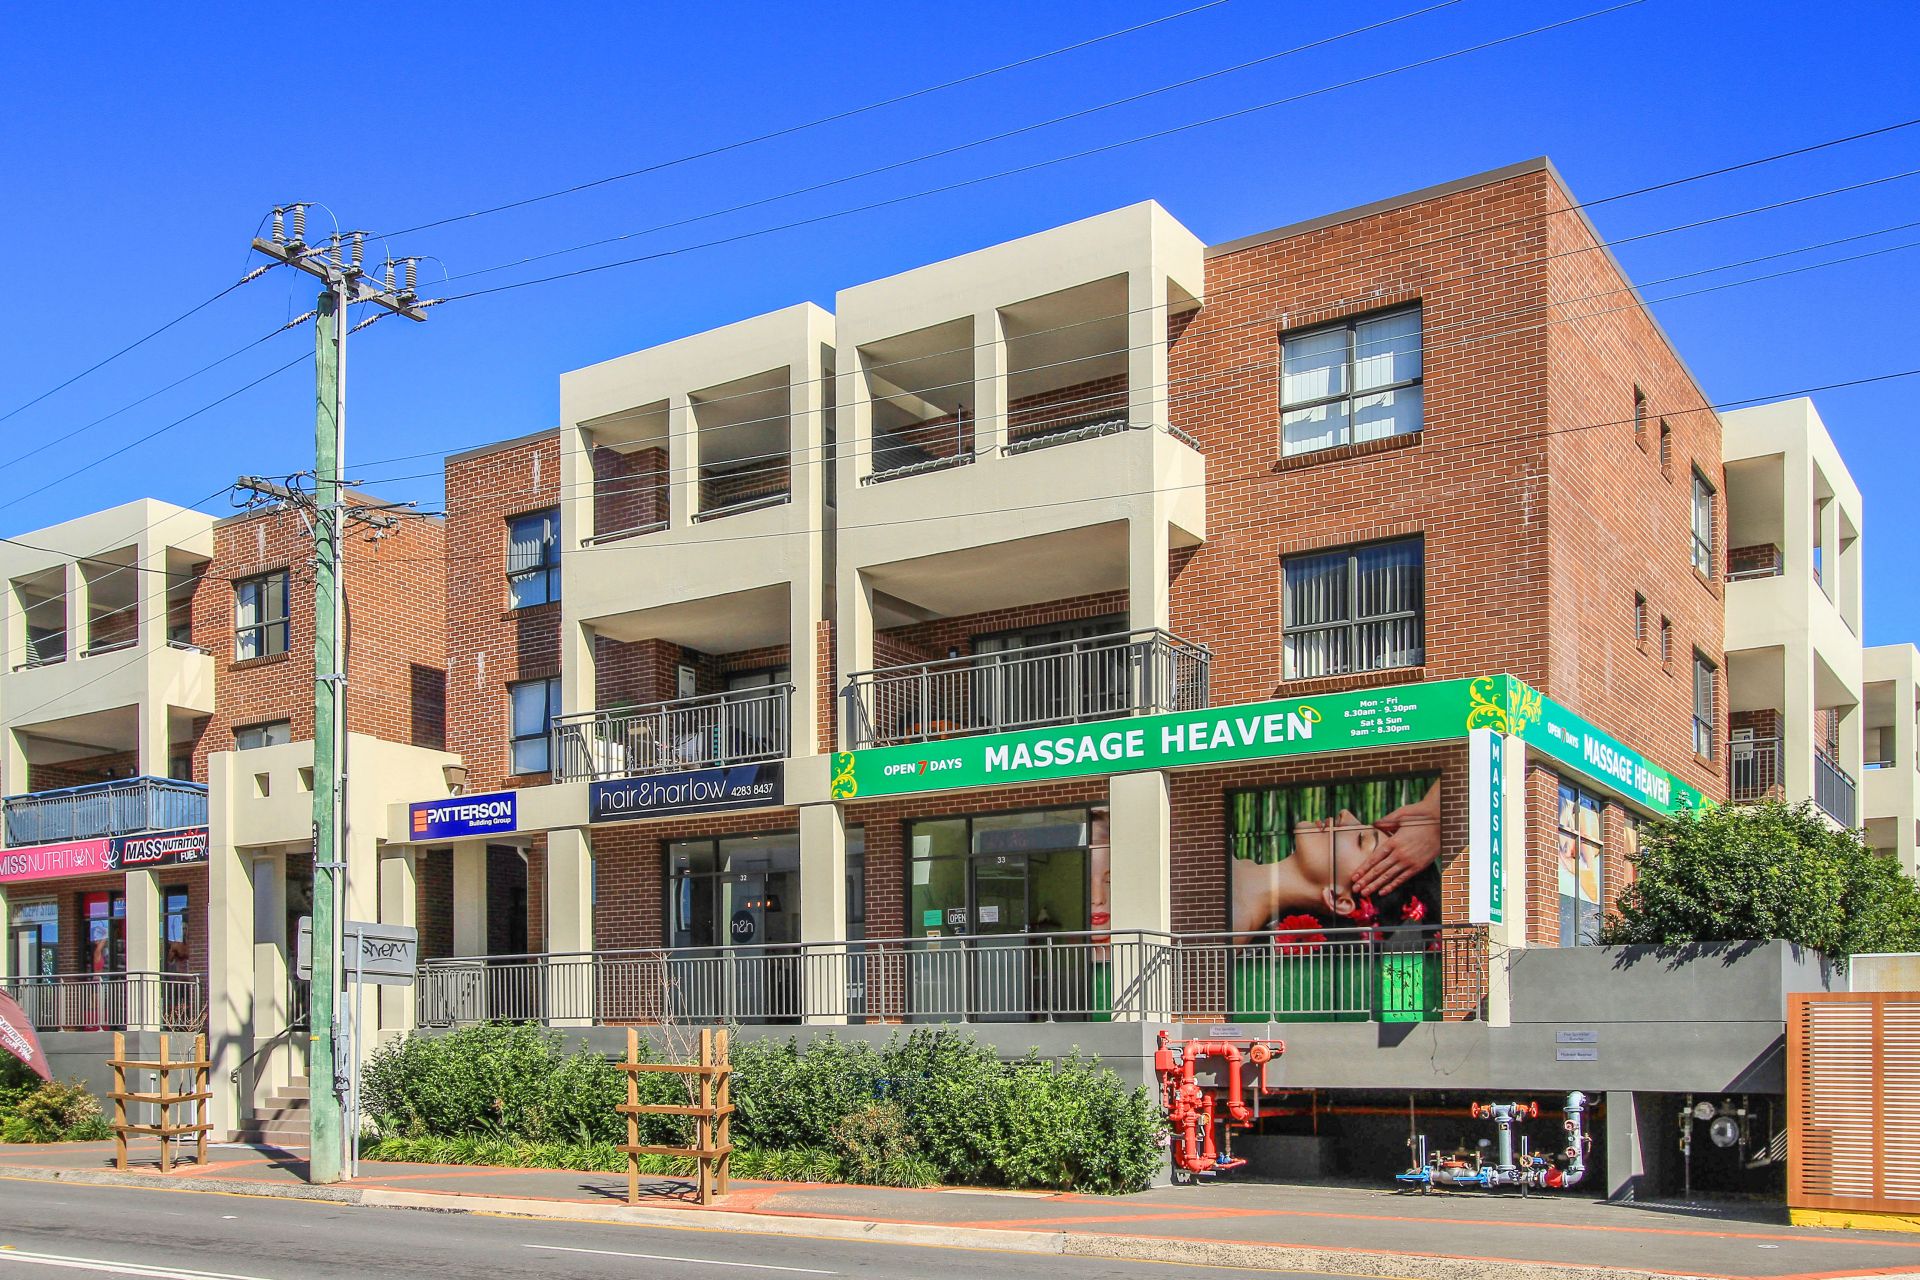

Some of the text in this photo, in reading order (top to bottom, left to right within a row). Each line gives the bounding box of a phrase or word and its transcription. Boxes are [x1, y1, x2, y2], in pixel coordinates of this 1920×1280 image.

[1386, 696, 1398, 704] Fri
[1344, 709, 1376, 717] 8.30am
[1384, 704, 1417, 713] 9.30pm
[1360, 719, 1374, 727] Sat
[1350, 729, 1369, 737] 9am
[1377, 725, 1410, 733] 8.30pm
[1548, 722, 1561, 739] OPEN
[1566, 732, 1579, 749] DAYS
[985, 710, 1313, 773] MASSAGE HEAVEN
[884, 757, 963, 776] OPEN 7 DAYS
[1584, 733, 1670, 806] MASSAGE HEAVEN
[731, 782, 774, 797] 4283 8437
[427, 801, 512, 824] PATTERSON
[469, 817, 511, 827] Building Group
[1492, 743, 1500, 902] MASSAGE
[125, 835, 206, 861] MASS NUTRITION
[181, 849, 198, 862] FUEL
[997, 856, 1006, 864] 33
[740, 874, 748, 882] 32
[949, 913, 966, 923] OPEN
[731, 919, 754, 933] h&h
